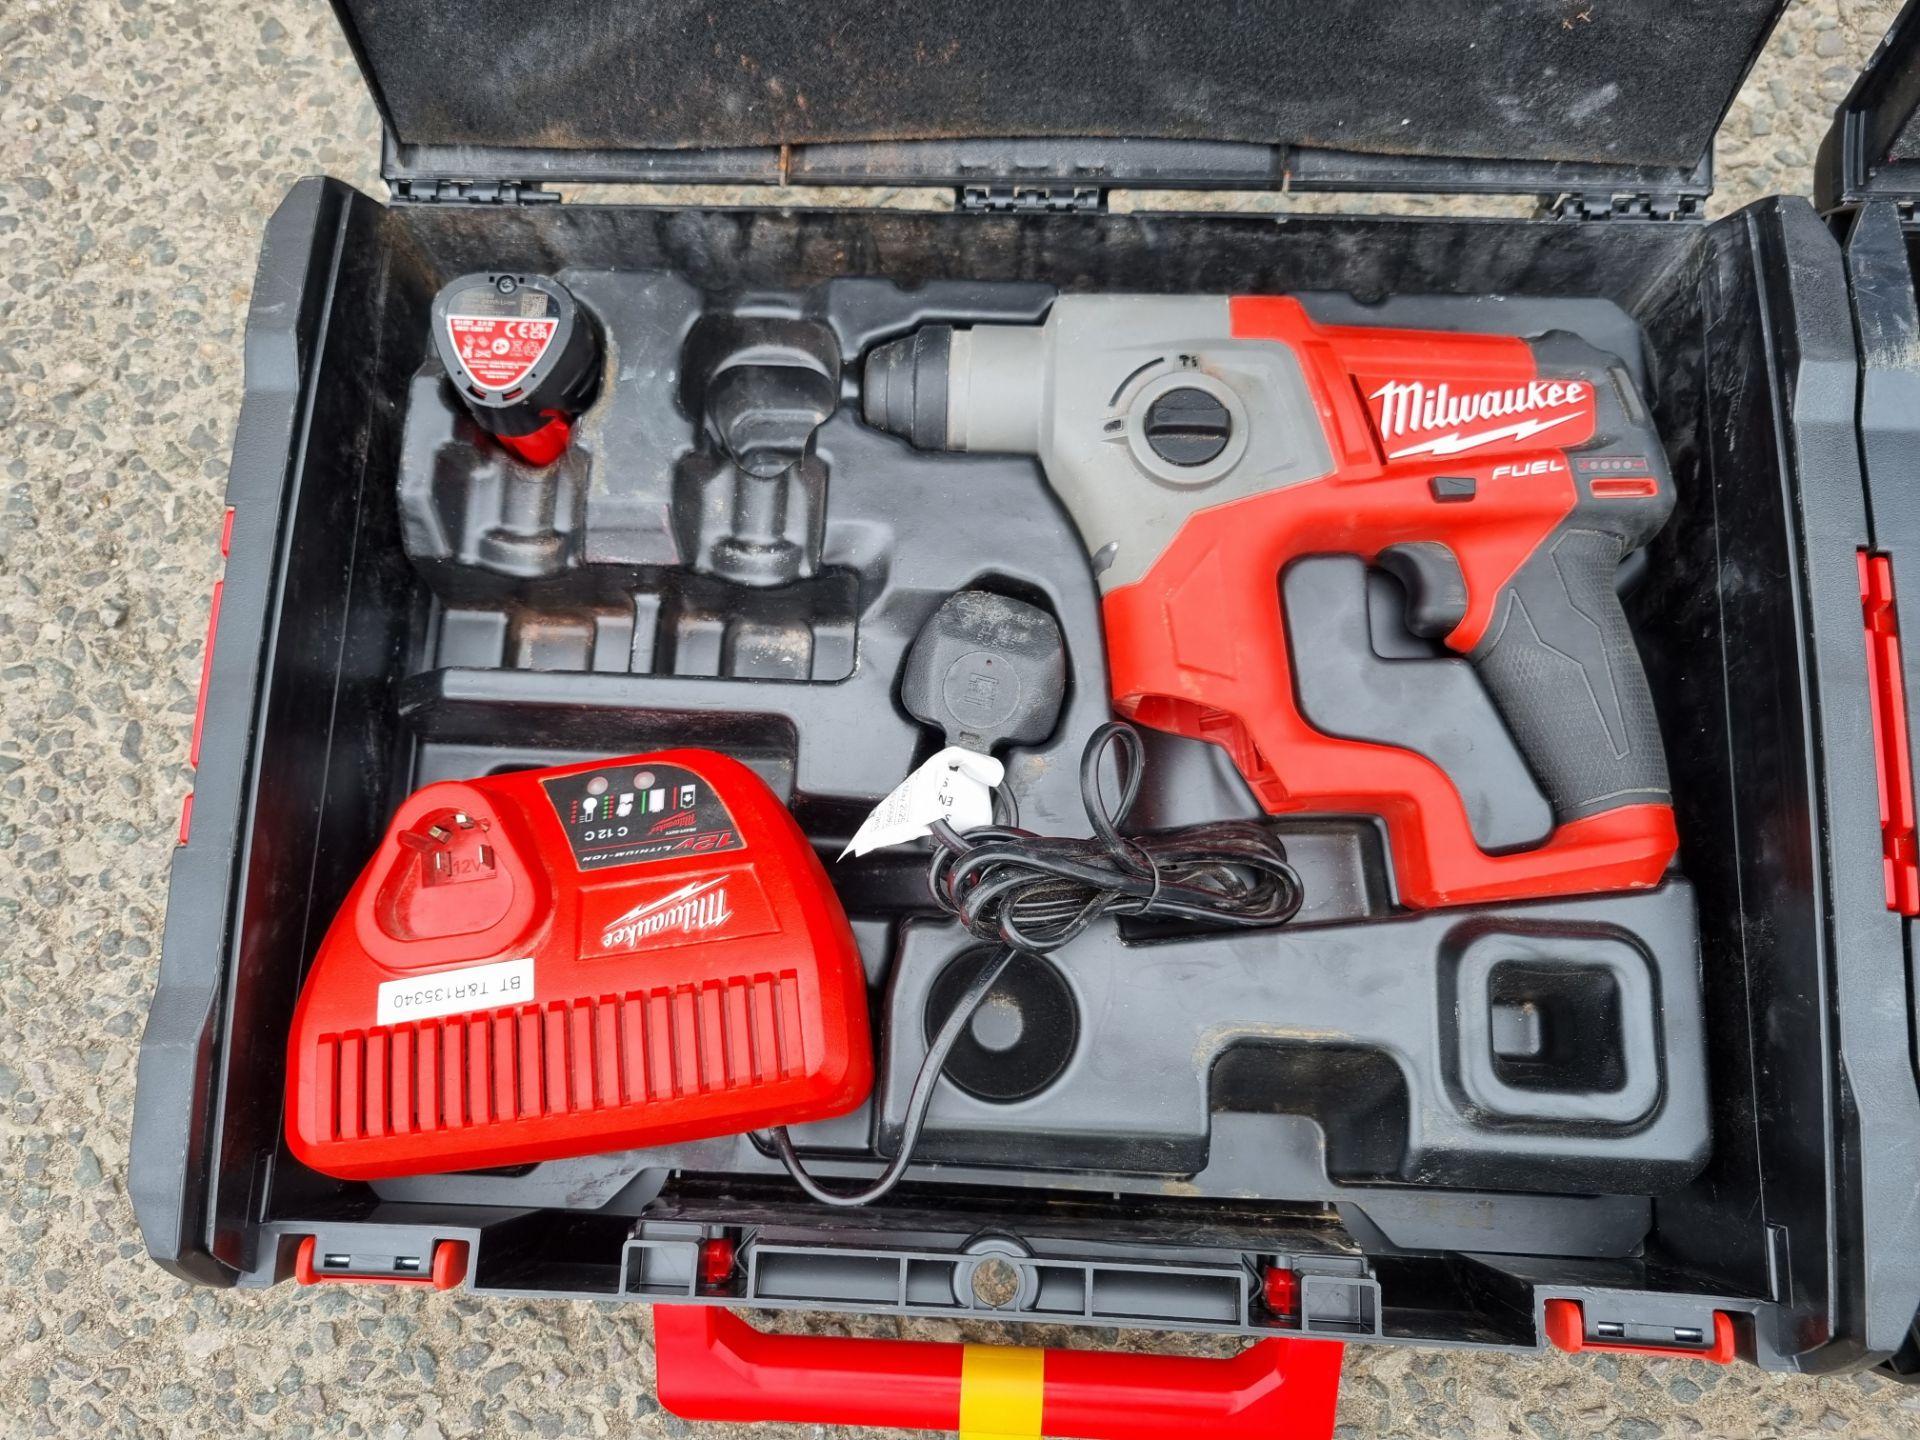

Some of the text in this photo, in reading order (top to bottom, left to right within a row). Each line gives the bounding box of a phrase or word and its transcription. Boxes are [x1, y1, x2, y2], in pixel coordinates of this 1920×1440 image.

[1369, 379, 1588, 442] Milwaukee
[1492, 459, 1565, 481] FUEL
[584, 826, 629, 842] C 12 C
[602, 888, 734, 948] Milwaukee
[393, 975, 522, 1009] BT T&R135340
